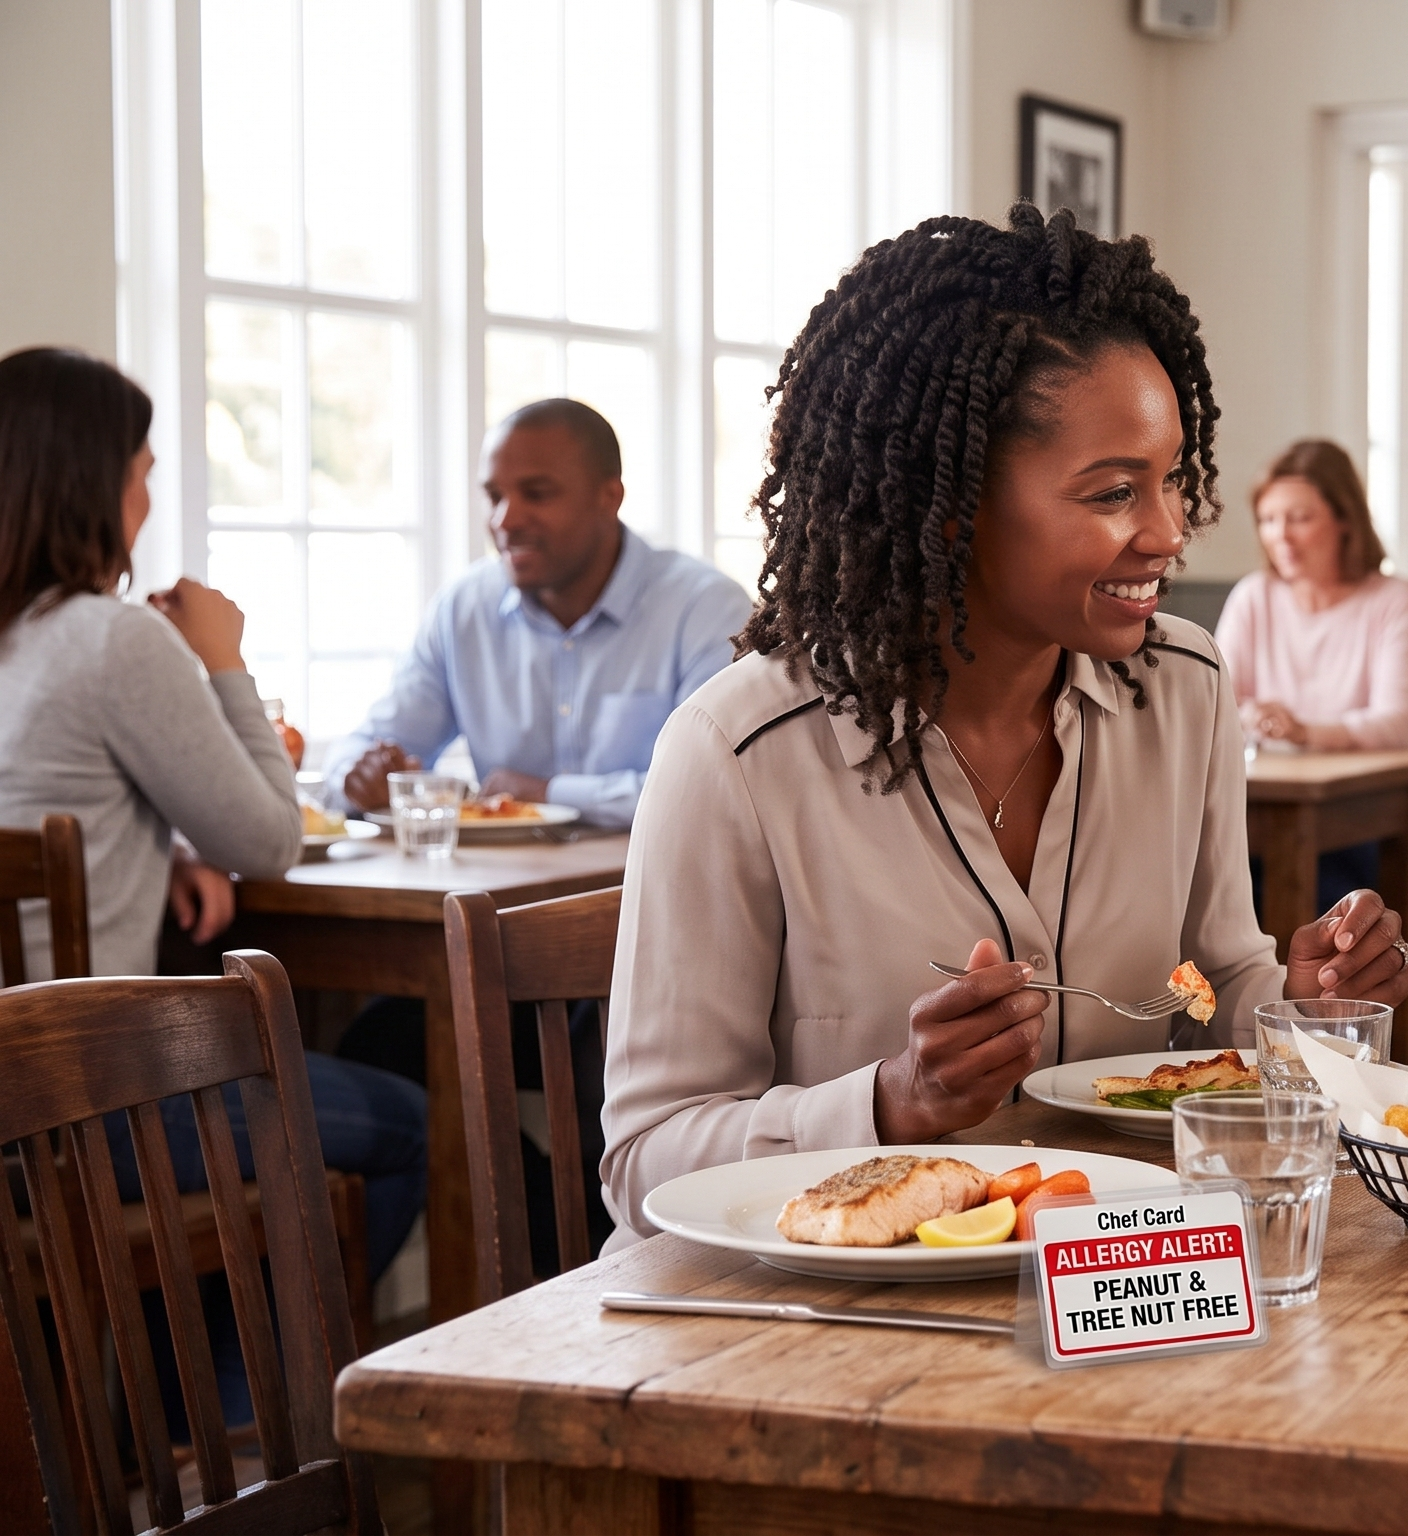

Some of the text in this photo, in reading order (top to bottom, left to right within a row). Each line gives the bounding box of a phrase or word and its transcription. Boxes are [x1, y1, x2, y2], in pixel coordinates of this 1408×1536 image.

[1097, 1205, 1185, 1230] Chef Card
[1056, 1231, 1234, 1270] ALLERGY ALERT:
[1093, 1270, 1207, 1302] PEANUT &
[1066, 1295, 1239, 1333] TREE NUT FREE
